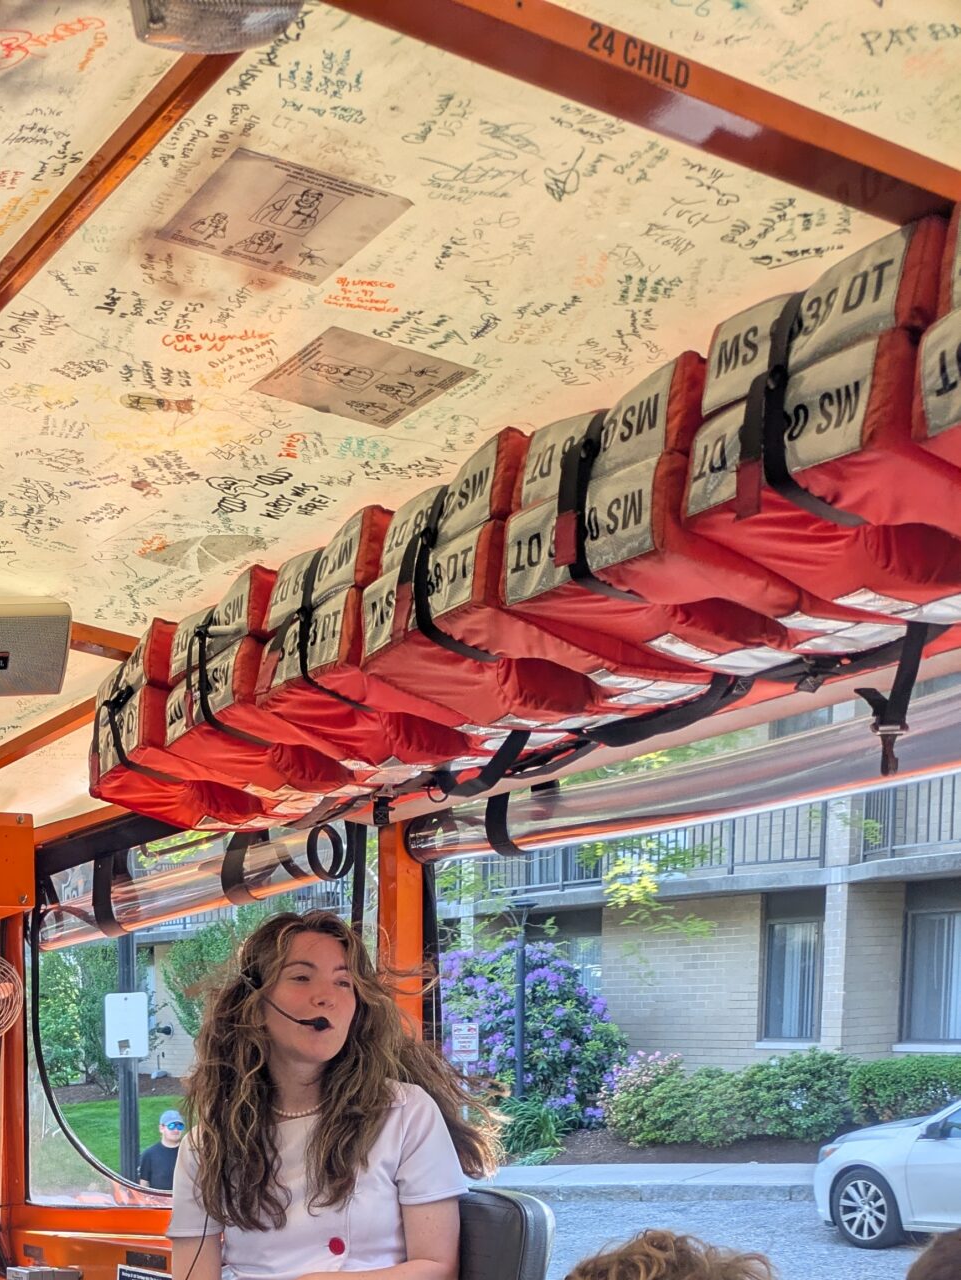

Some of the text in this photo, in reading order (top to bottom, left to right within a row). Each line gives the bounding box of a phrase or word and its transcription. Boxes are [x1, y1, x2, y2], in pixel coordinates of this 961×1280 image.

[587, 22, 690, 89] 24 CHILD
[715, 326, 759, 379] MS
[842, 258, 895, 315] DT
[619, 393, 660, 442] MS
[815, 381, 860, 435] MS
[526, 443, 556, 486] DT
[693, 433, 728, 481] DT
[259, 482, 320, 520] KILROY WAS
[296, 494, 338, 518] HERE!
[458, 467, 490, 511] MS
[606, 488, 643, 535] MS
[446, 546, 474, 584] DT
[510, 532, 542, 574] DT
